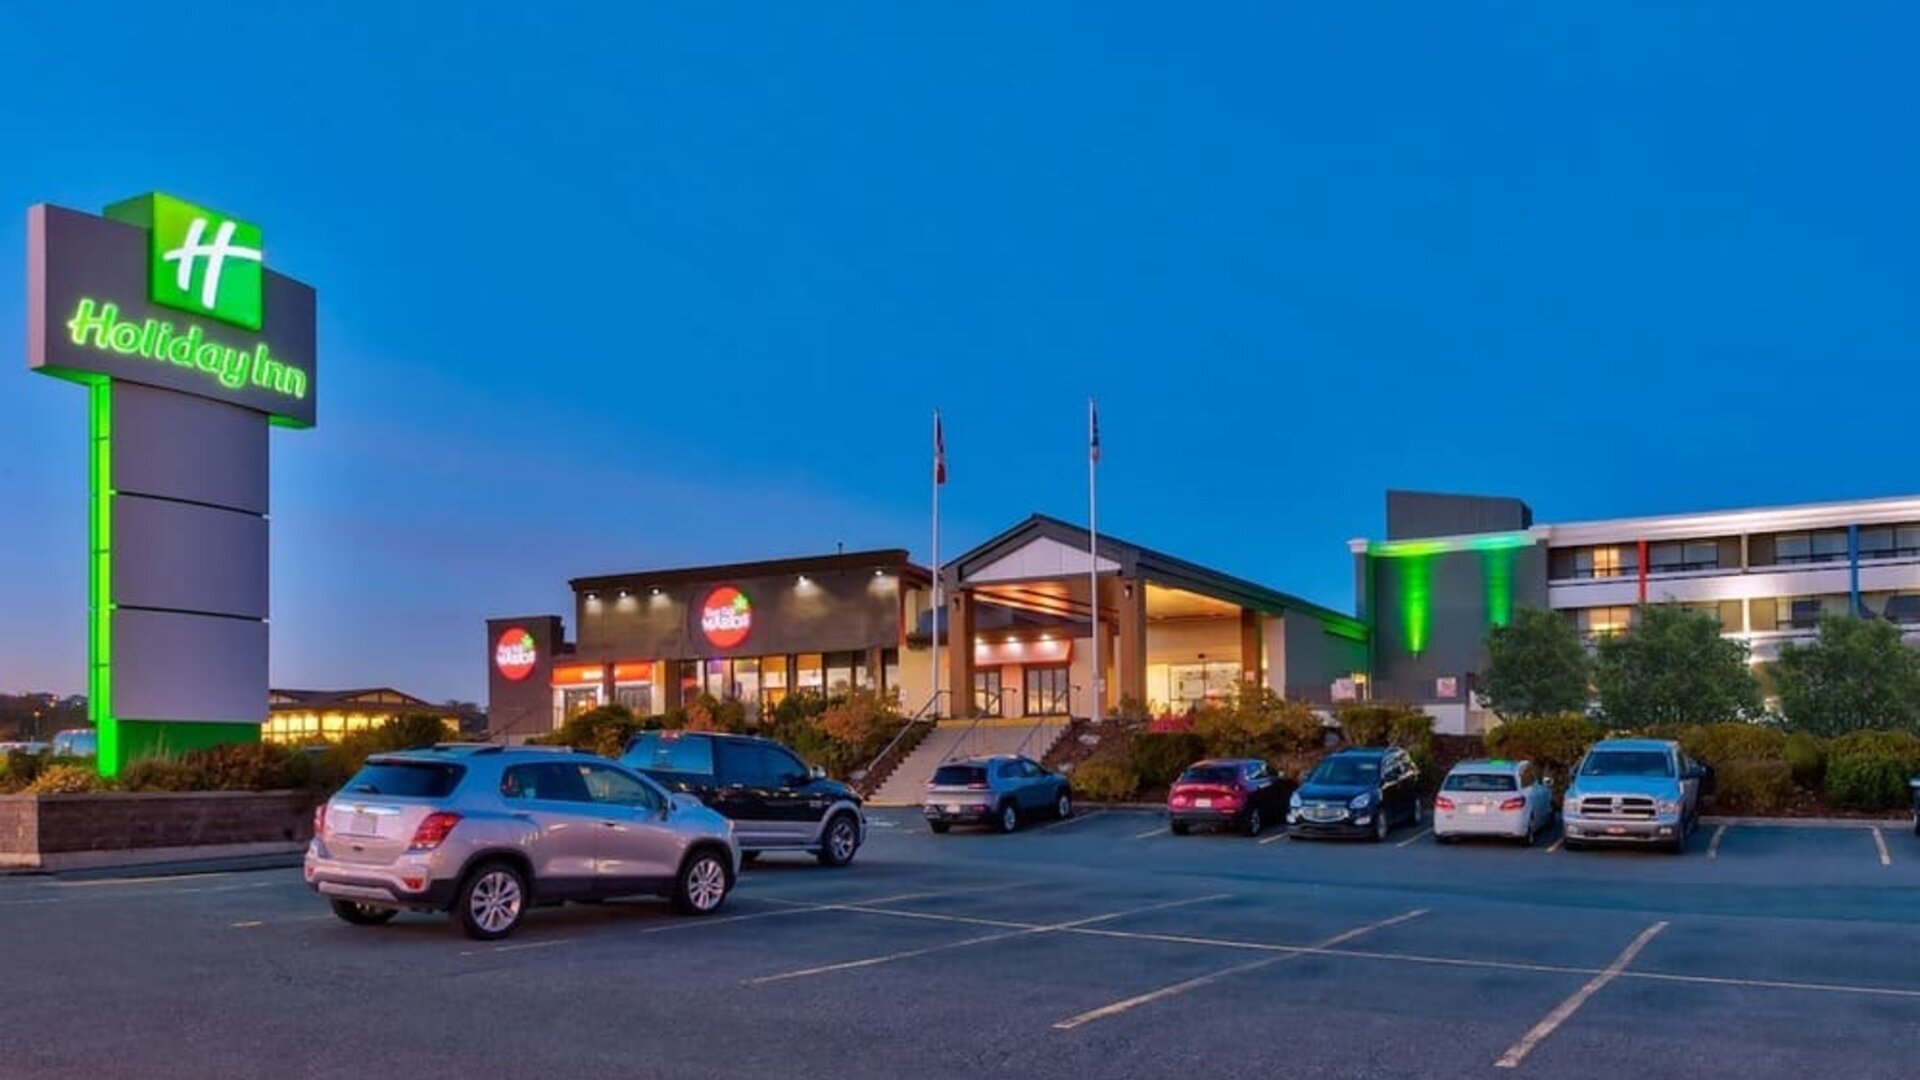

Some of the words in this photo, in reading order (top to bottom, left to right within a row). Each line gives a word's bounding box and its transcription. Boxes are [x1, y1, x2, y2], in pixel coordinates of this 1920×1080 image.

[163, 218, 262, 309] H
[67, 297, 249, 388] Holiday
[252, 343, 307, 398] Inn
